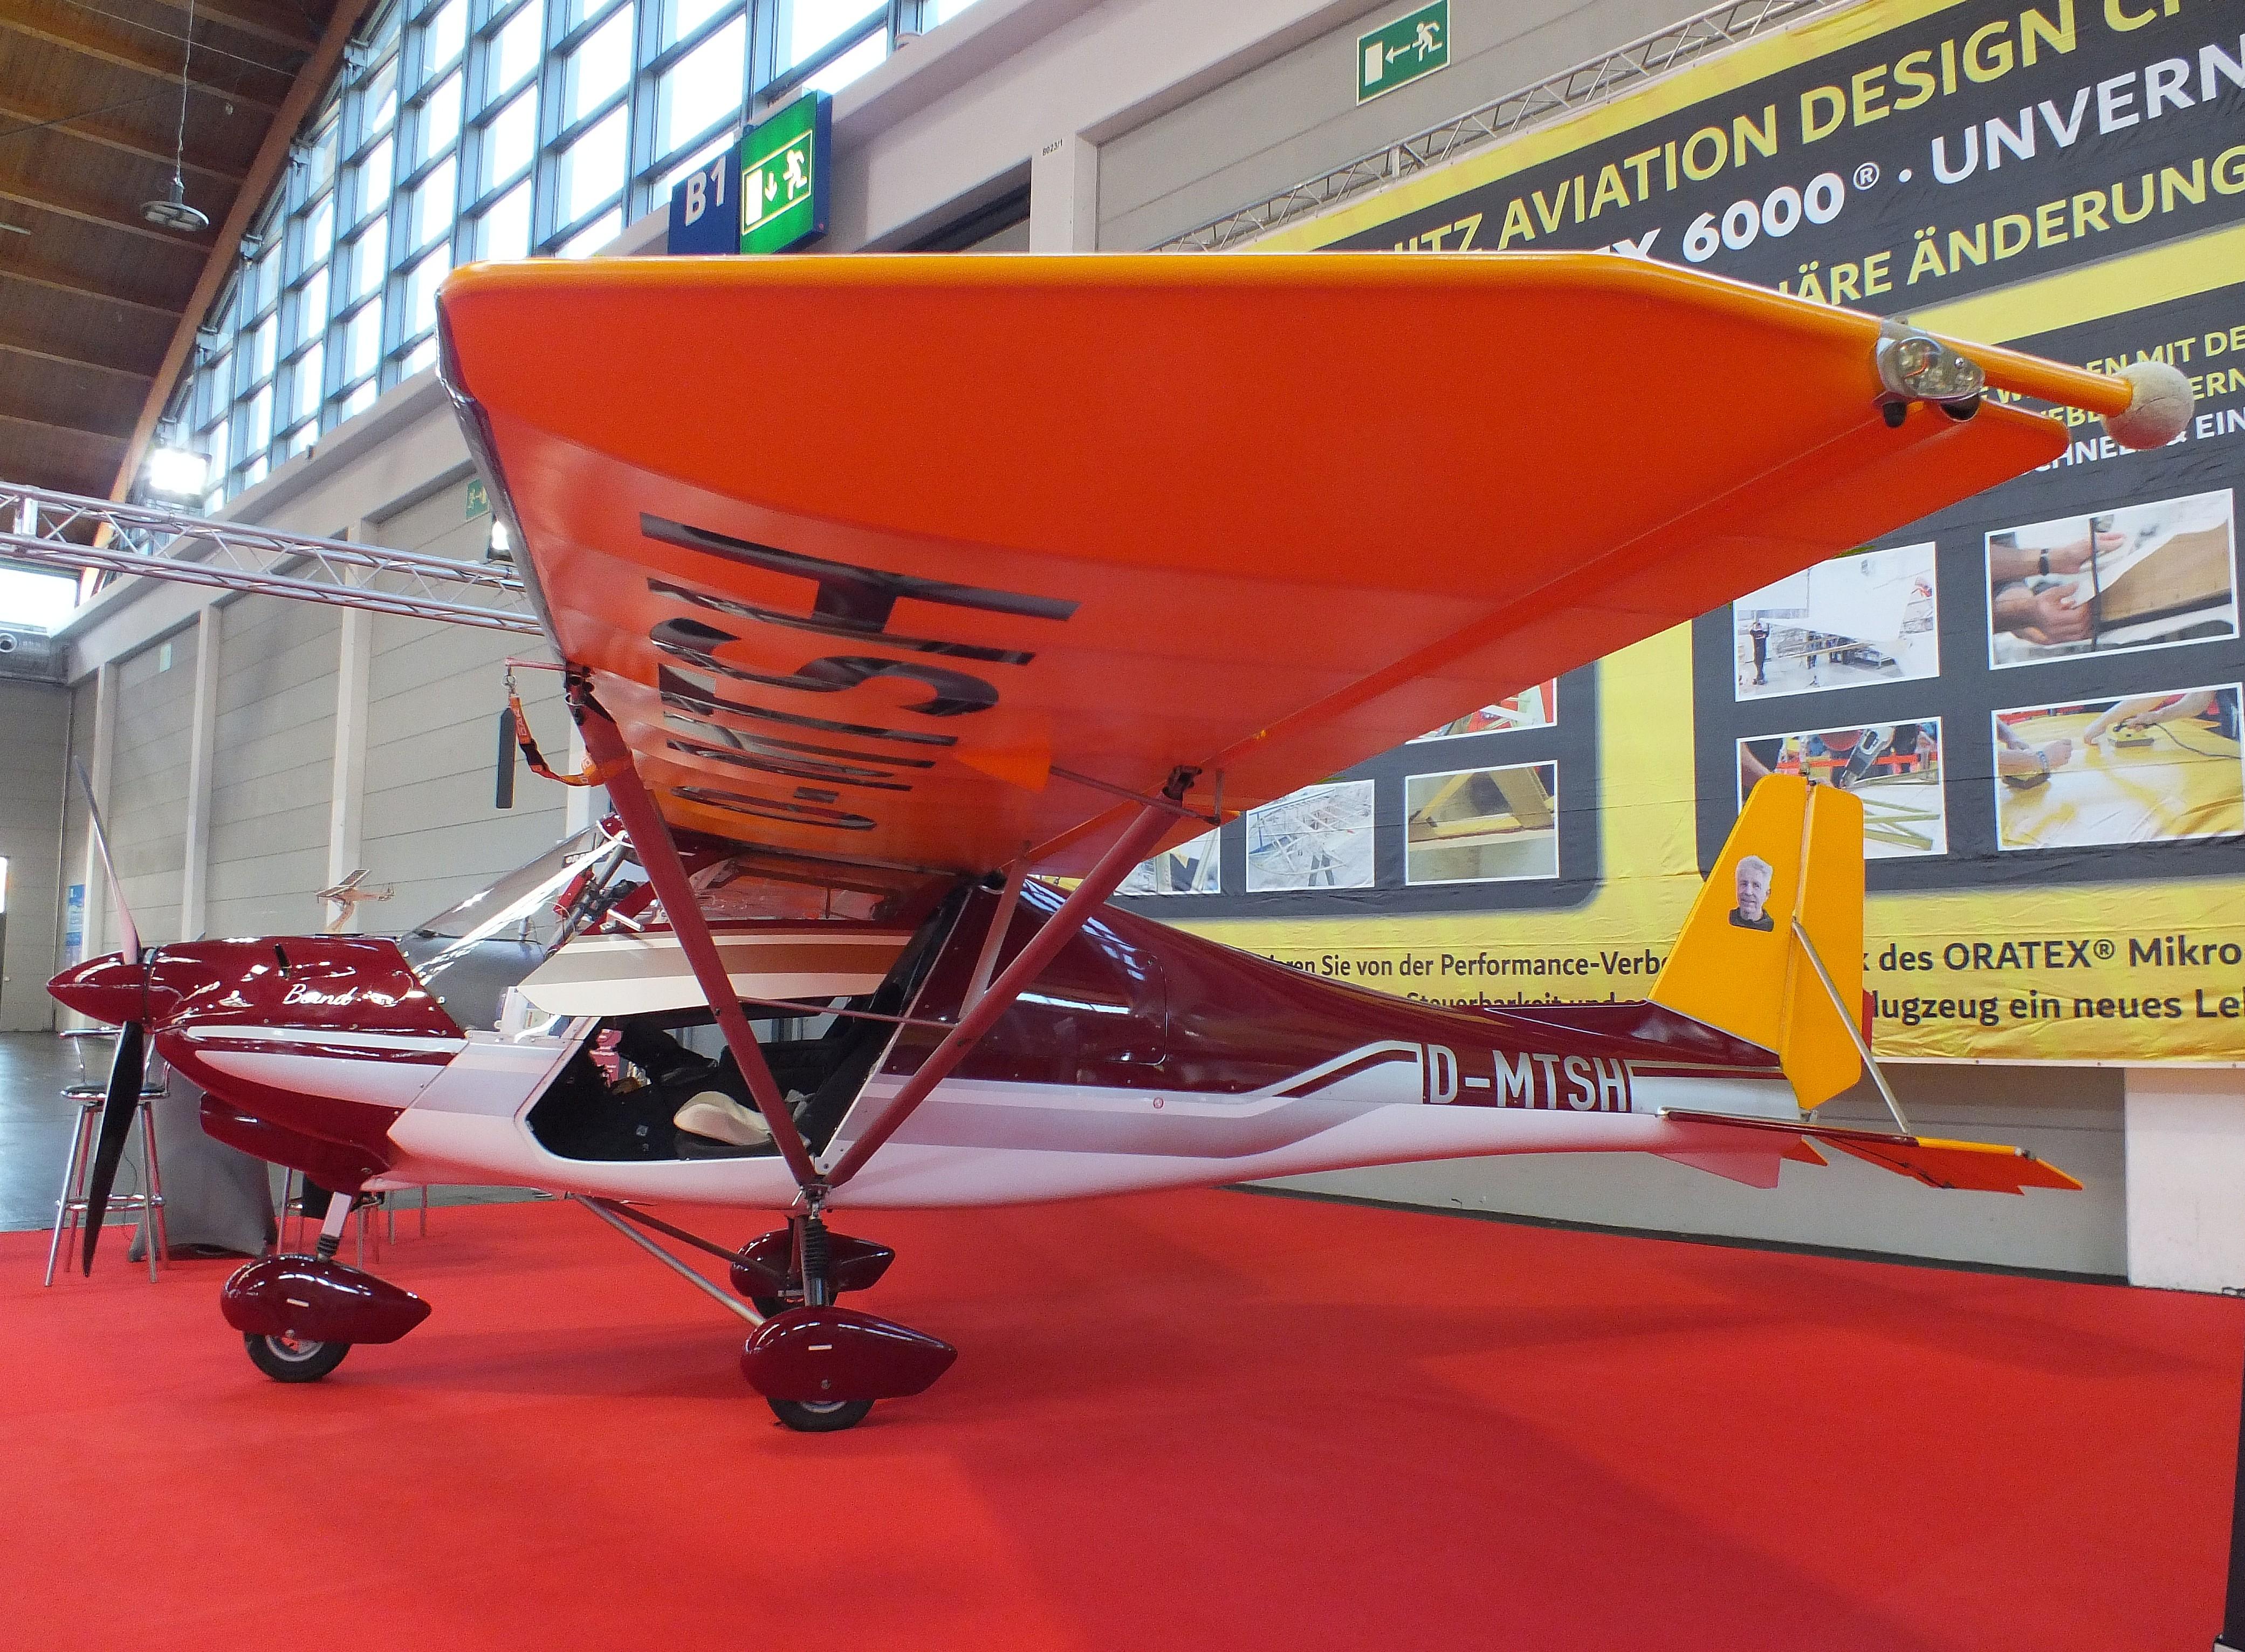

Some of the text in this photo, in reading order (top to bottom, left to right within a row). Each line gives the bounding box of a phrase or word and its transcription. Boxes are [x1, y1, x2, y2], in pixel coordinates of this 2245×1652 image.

[1497, 104, 1778, 251] AVIATION
[1800, 0, 2076, 145] DESIGN
[1931, 33, 2245, 185] UNVERN
[685, 155, 726, 227] B1
[1779, 145, 2245, 306] ÄRE ÄNDERUNG
[2136, 337, 2196, 366] MIT
[1321, 954, 1351, 976] Sie
[1356, 960, 1393, 976] von
[1399, 953, 1434, 976] der
[1879, 943, 1934, 971] des
[2009, 989, 2061, 1019] ein
[2074, 997, 2182, 1019] neues
[2195, 986, 2245, 1018] Le
[1428, 1043, 1628, 1112] D-MTSH
